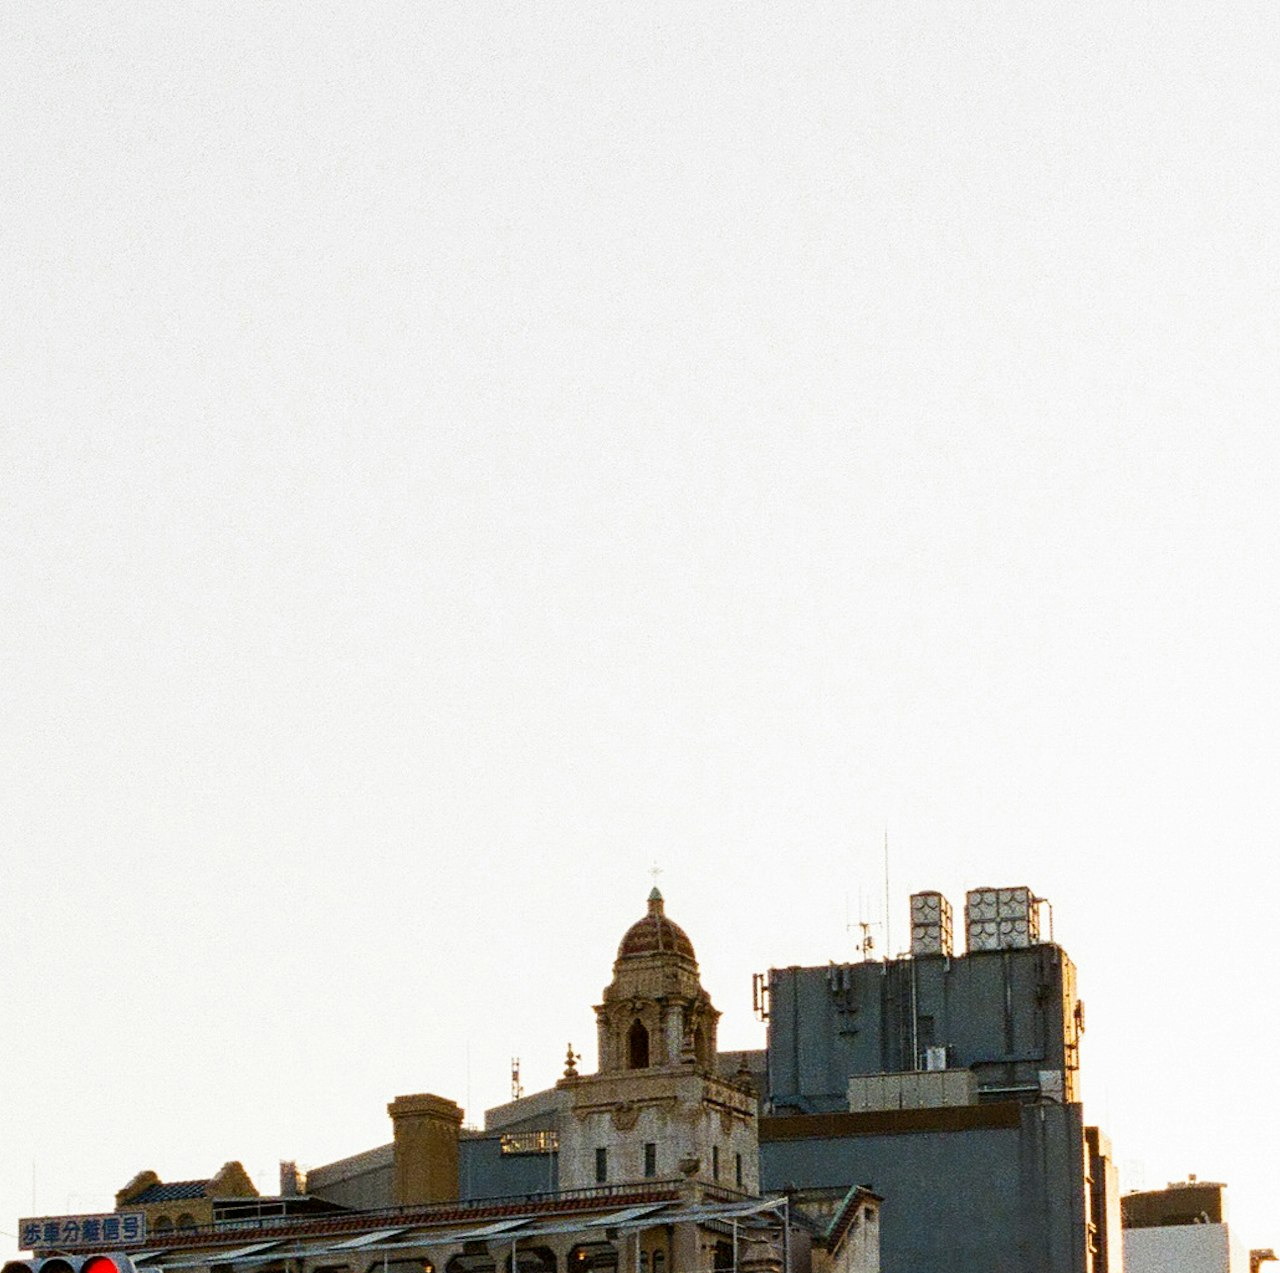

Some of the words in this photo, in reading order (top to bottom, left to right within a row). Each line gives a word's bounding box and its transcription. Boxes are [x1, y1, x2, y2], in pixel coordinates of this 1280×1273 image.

[23, 1217, 138, 1245] 歩車分離信号
